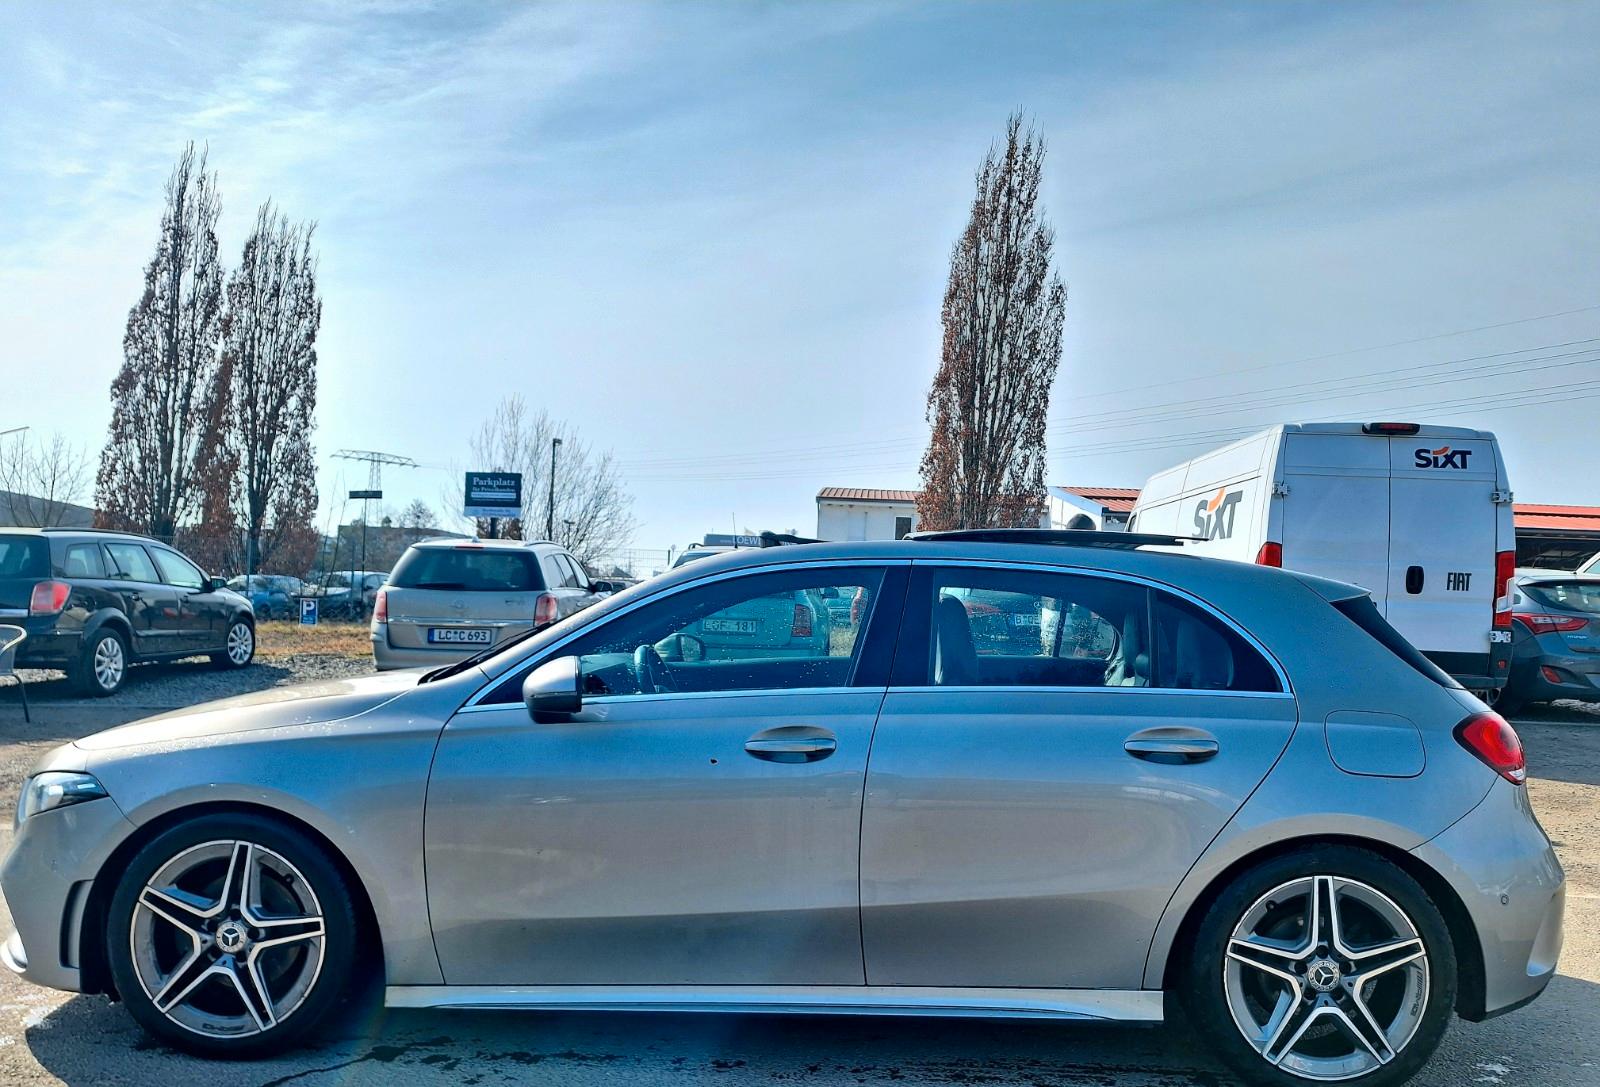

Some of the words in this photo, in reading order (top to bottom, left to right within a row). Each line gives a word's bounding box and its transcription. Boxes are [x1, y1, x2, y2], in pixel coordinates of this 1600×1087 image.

[472, 476, 516, 487] Parkplatz
[1447, 572, 1473, 592] FIAT
[302, 600, 315, 615] P
[438, 630, 452, 640] LC
[467, 630, 487, 640] 693
